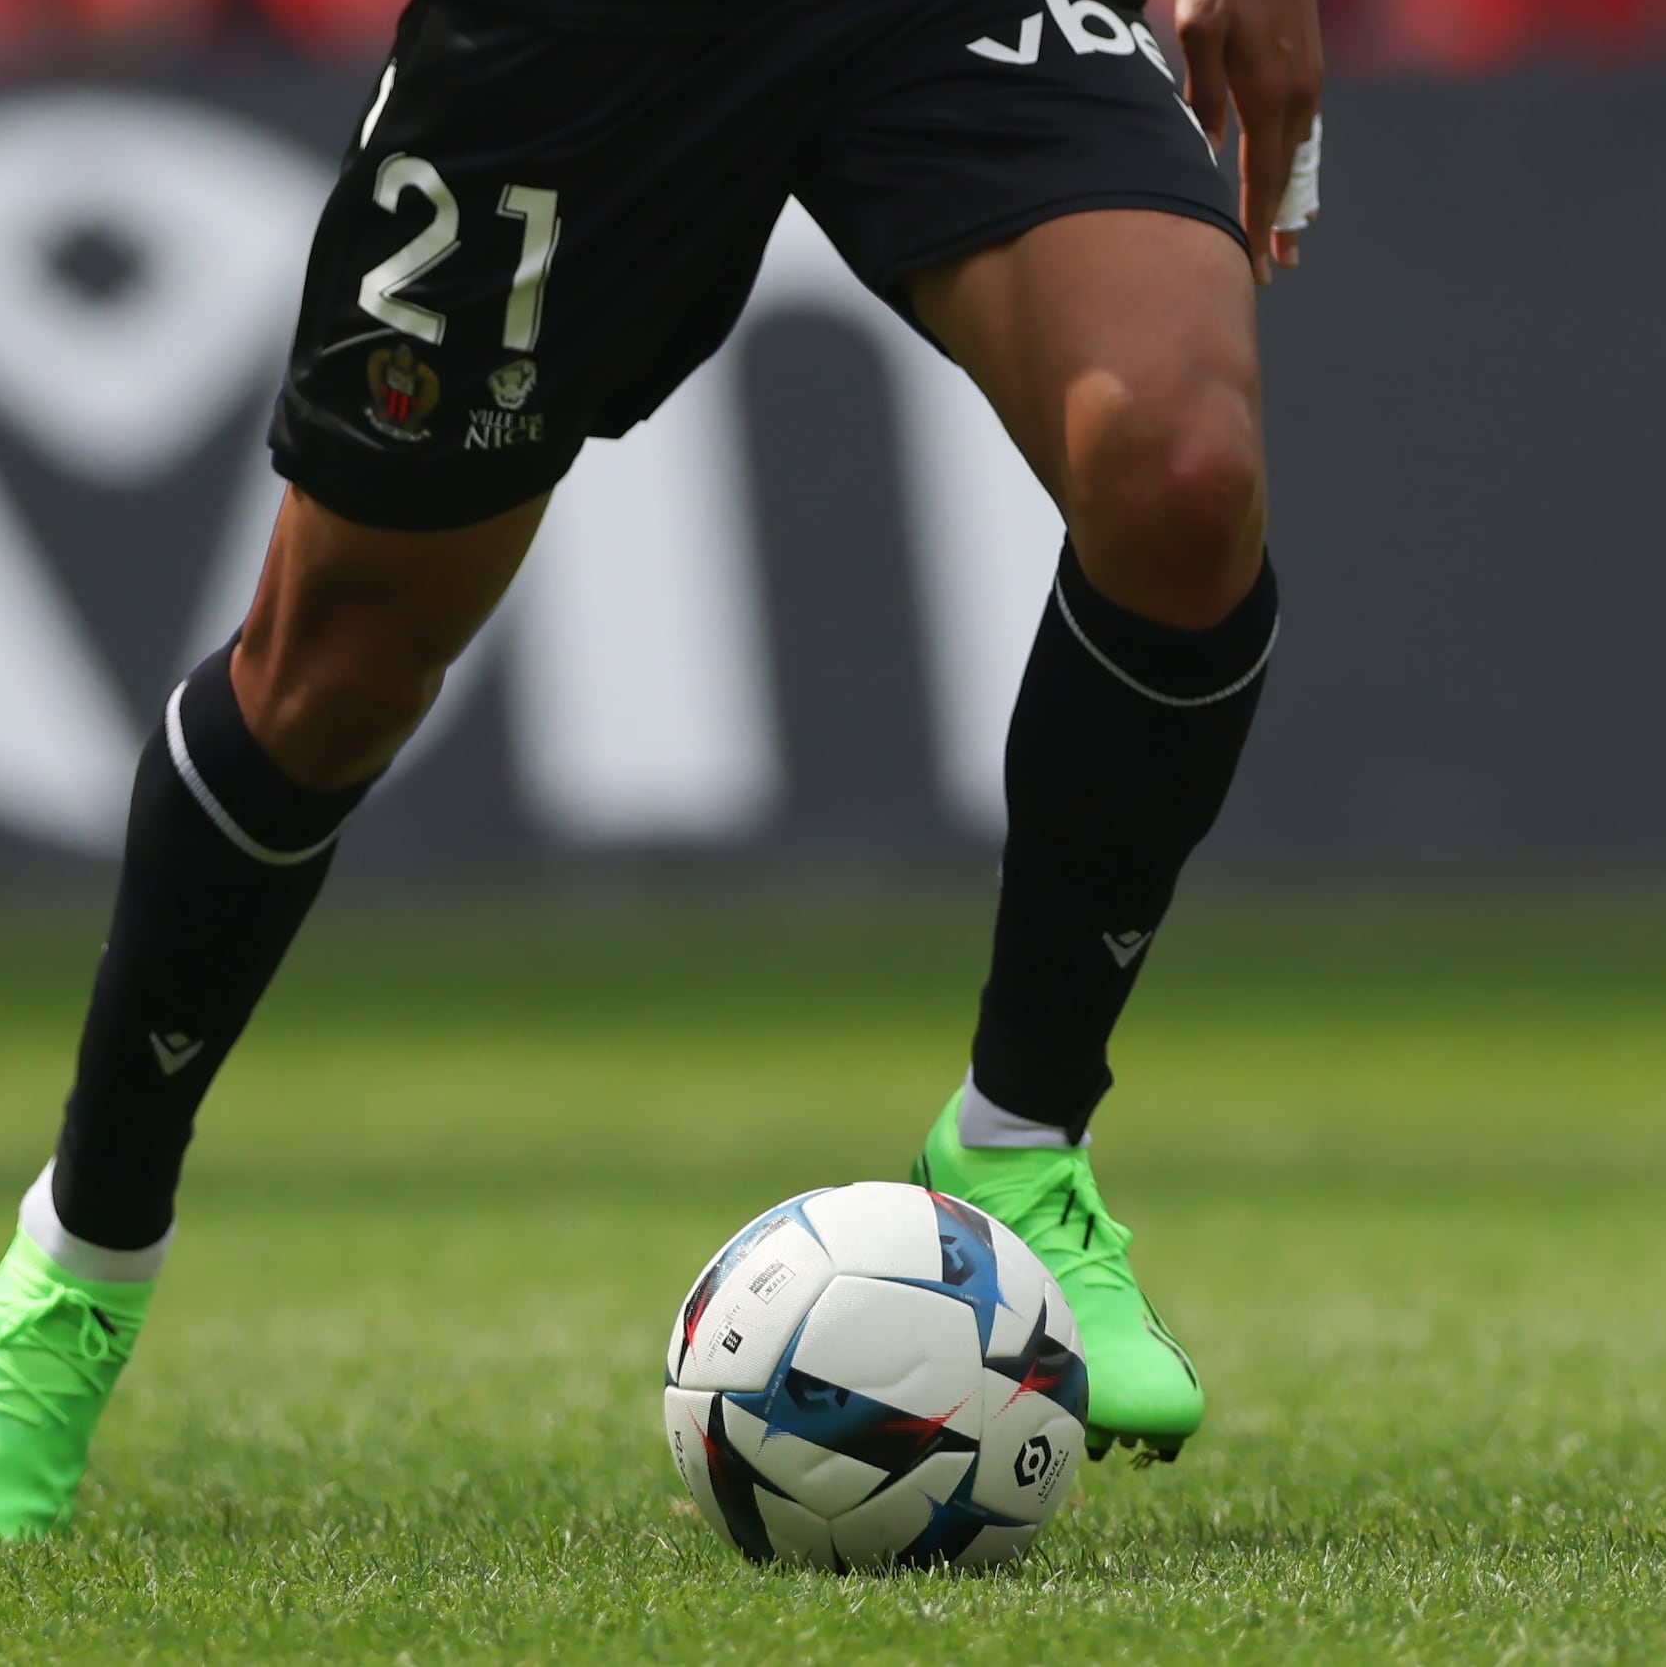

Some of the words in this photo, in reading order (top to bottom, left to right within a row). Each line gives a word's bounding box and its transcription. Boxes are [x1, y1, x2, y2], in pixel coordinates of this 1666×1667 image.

[357, 151, 562, 352] 21
[463, 424, 543, 451] NICE
[1038, 1459, 1060, 1497] LIGUE
